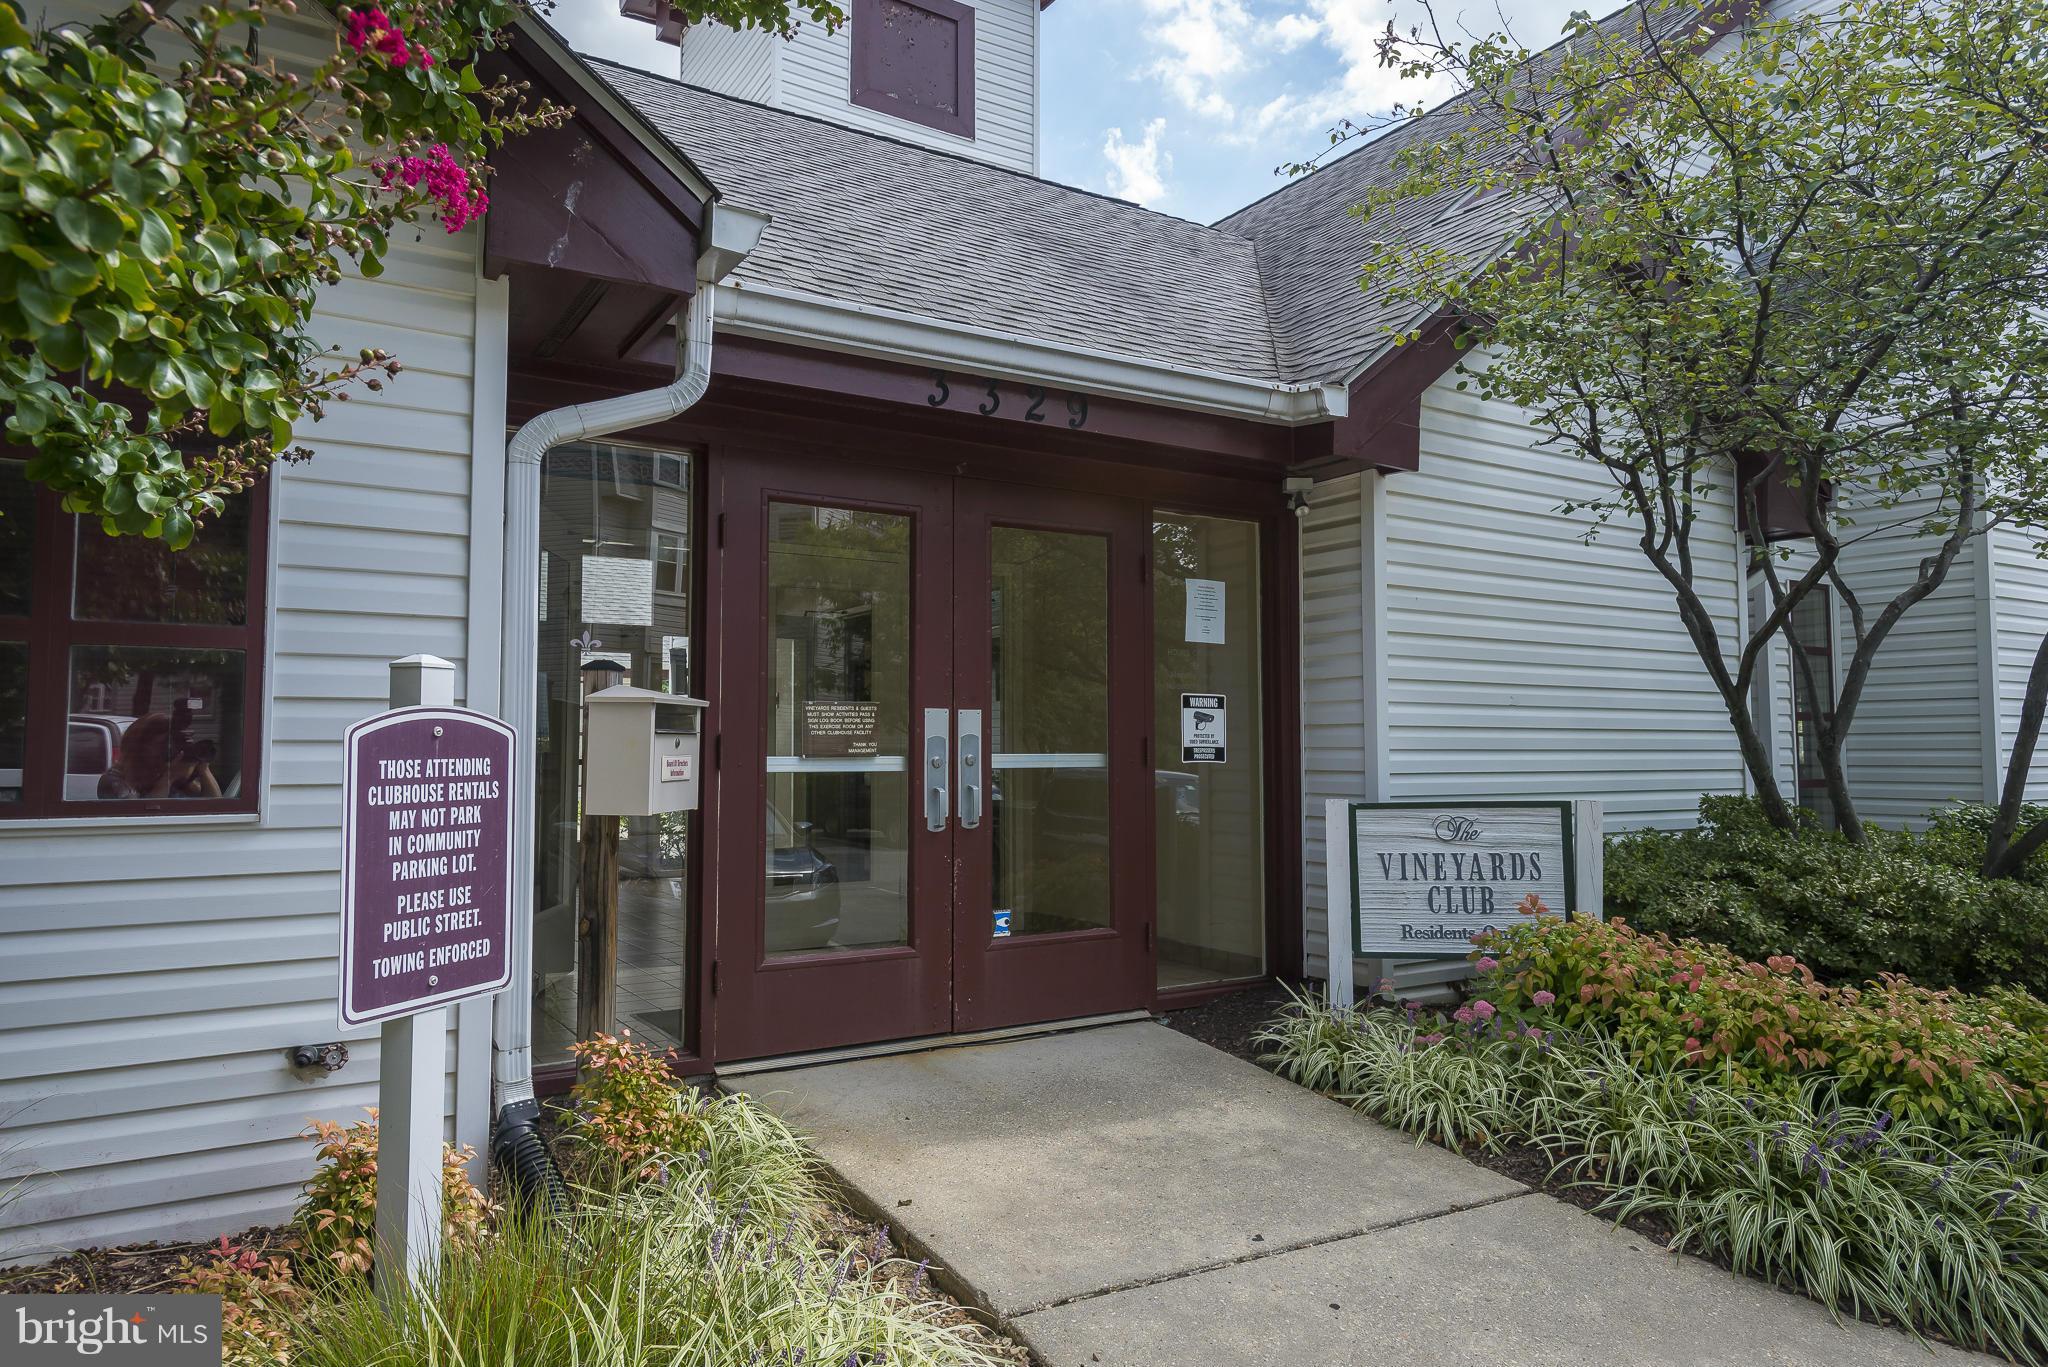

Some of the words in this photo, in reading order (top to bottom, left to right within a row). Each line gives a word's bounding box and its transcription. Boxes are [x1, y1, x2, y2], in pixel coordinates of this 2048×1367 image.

[928, 369, 1088, 428] 3329
[1190, 697, 1218, 708] WARNING
[379, 759, 421, 779] THOSE
[426, 757, 490, 778] ATTENDING
[368, 783, 444, 806] CLUBHOUSE
[449, 781, 499, 801] RENTALS
[389, 810, 416, 830] MAY
[421, 807, 446, 828] NOT
[450, 805, 481, 826] PARK
[1432, 814, 1483, 841] The
[389, 836, 402, 856] IN
[407, 829, 481, 855] COMMUNITY
[392, 857, 448, 881] PARKING
[452, 854, 476, 873] LOT.
[1377, 852, 1542, 881] VINEYARDS
[397, 888, 445, 915] PLEASE
[449, 885, 472, 907] USE
[1427, 885, 1495, 914] CLUB
[384, 915, 431, 943] PUBLIC
[435, 909, 482, 934] STREET.
[1400, 924, 1476, 940] Residents
[373, 950, 425, 979] TOWING
[429, 938, 490, 968] ENFORCED
